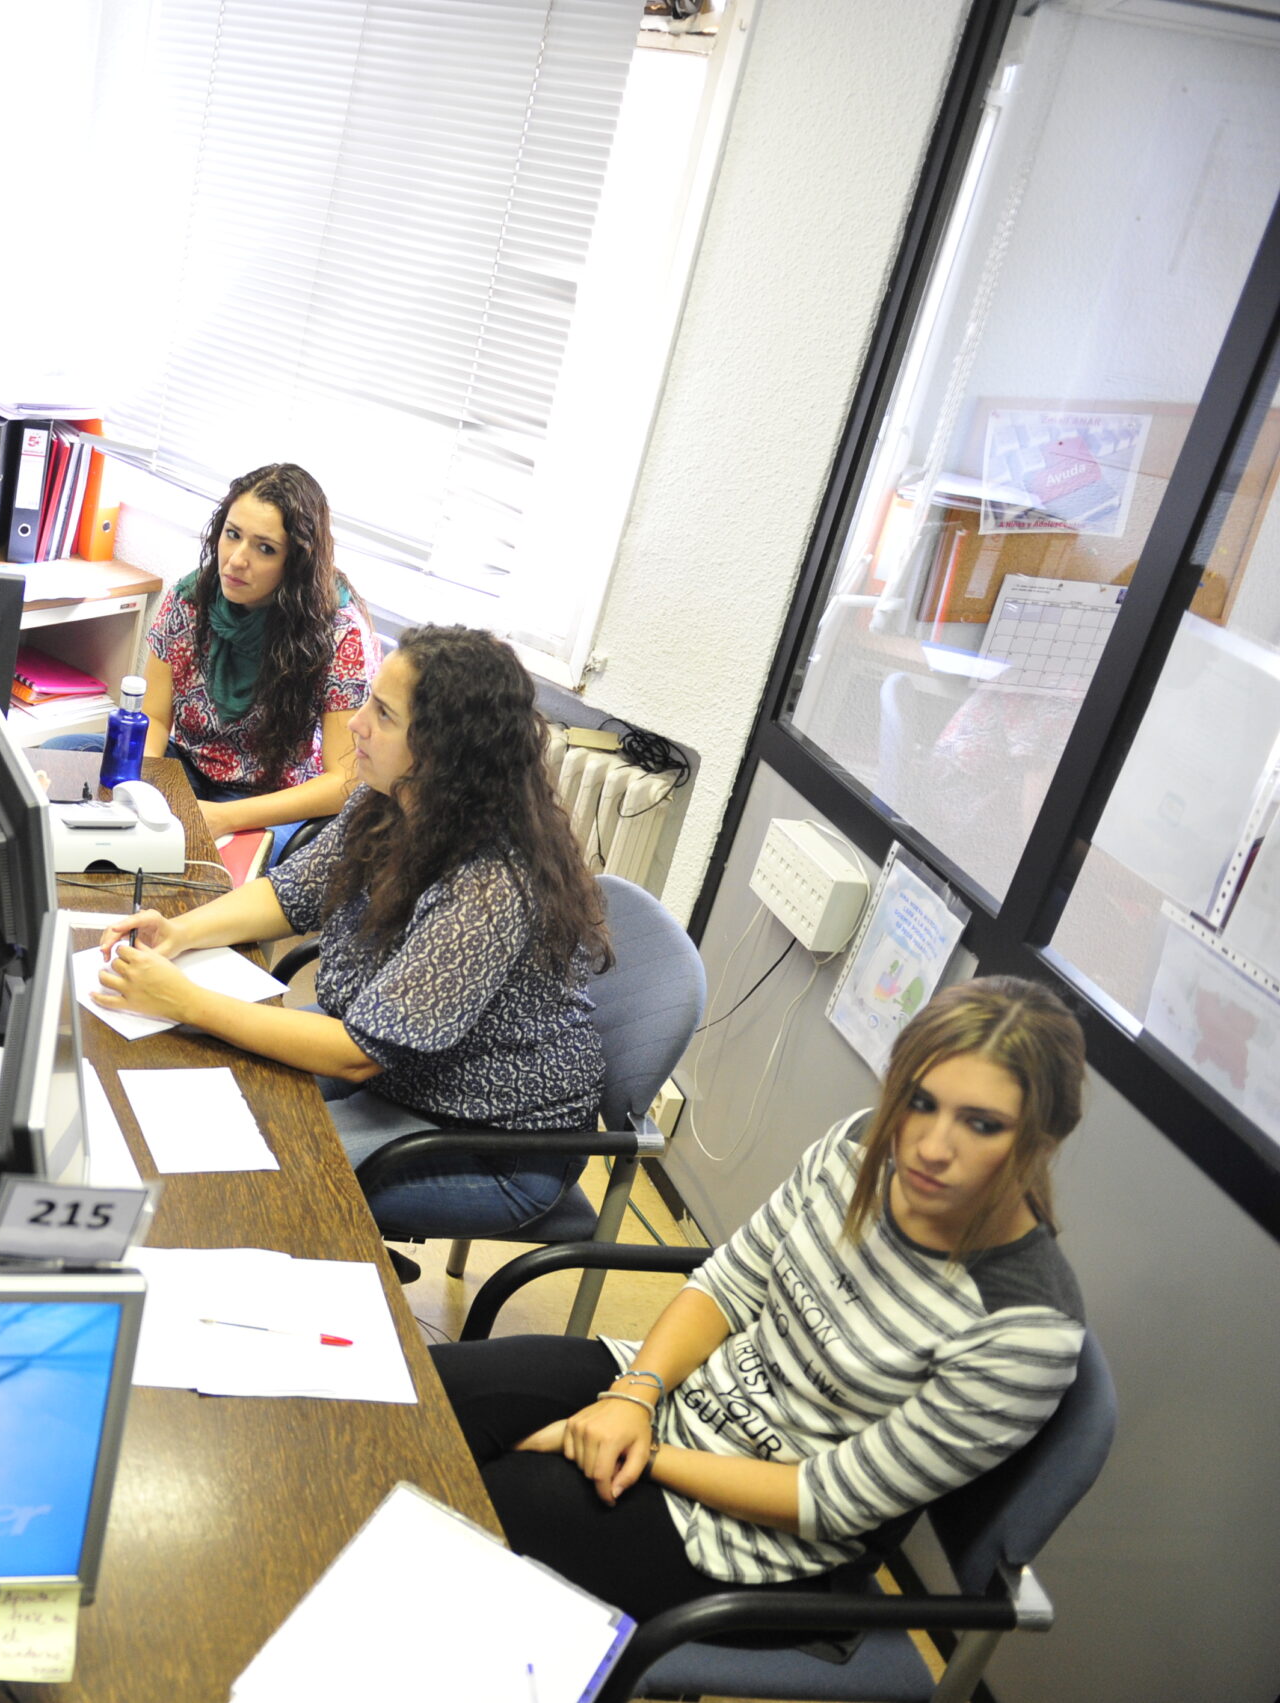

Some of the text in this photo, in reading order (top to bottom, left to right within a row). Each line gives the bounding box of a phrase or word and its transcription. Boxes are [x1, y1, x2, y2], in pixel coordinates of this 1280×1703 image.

[1046, 463, 1087, 486] Ayuda
[28, 1199, 115, 1231] 215
[772, 1299, 790, 1338] TO
[774, 1254, 841, 1349] LESSON
[735, 1339, 776, 1398] TRUST
[684, 1388, 734, 1436] GUT
[718, 1384, 782, 1462] YOUR
